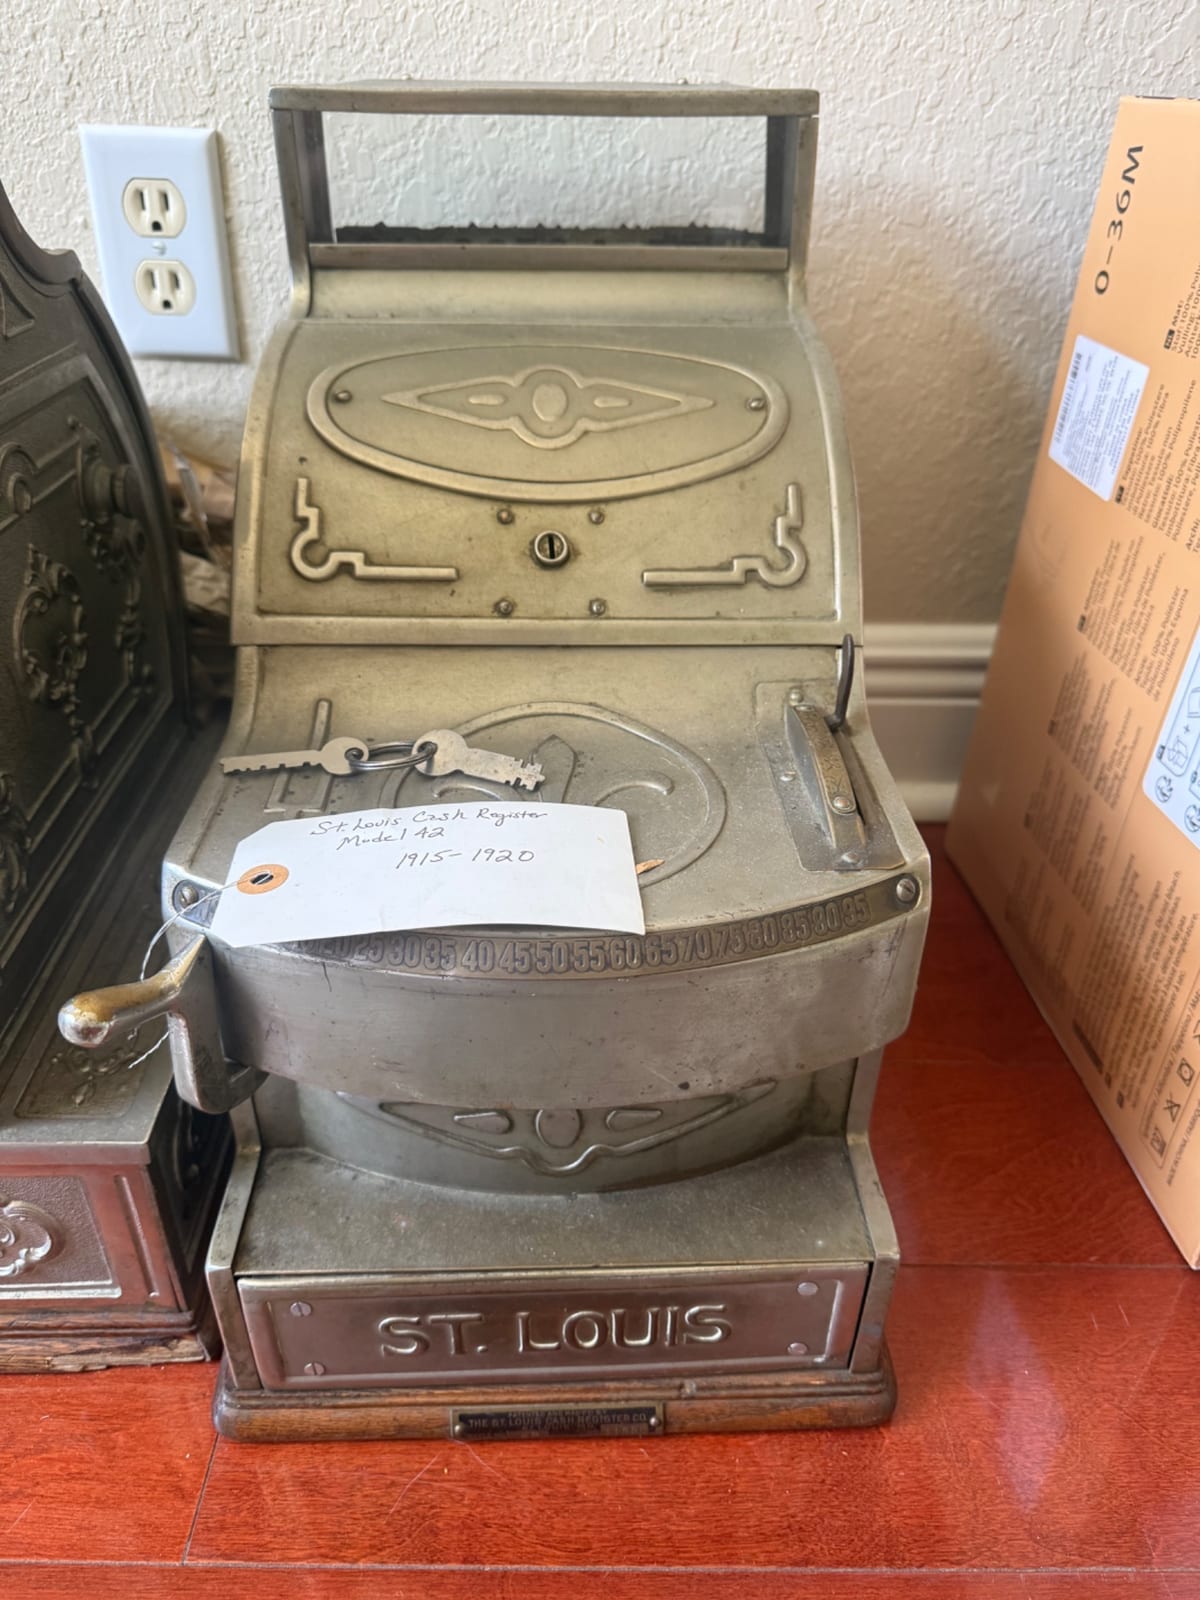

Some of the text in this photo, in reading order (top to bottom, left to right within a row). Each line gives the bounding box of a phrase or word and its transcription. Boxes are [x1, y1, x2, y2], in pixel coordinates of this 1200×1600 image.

[1171, 299, 1184, 326] Mat:
[1179, 290, 1194, 323] 100%
[1176, 311, 1196, 355] Vulling:
[1146, 418, 1160, 449] 100%
[1157, 450, 1172, 482] 100%
[1168, 378, 1197, 451] Polipropilene
[1134, 435, 1147, 466] 100%
[1151, 472, 1174, 529] Giocattoli:
[1158, 489, 1177, 533] Tessuto:
[1173, 456, 1188, 489] 100%
[310, 807, 548, 836] St. Louis Cash Register
[336, 826, 445, 851] Model 42
[396, 847, 535, 870] 1915- 1920
[388, 936, 422, 968] 30
[424, 936, 456, 970] 35
[461, 938, 497, 973] 40
[500, 940, 531, 974] 45
[534, 940, 570, 974] 50
[571, 938, 605, 973] 55
[608, 935, 641, 970] 60
[644, 934, 681, 968] 65
[681, 930, 712, 963] 70
[716, 926, 746, 959] 75
[781, 909, 811, 943] 85
[377, 1303, 732, 1358] ST. LOUIS
